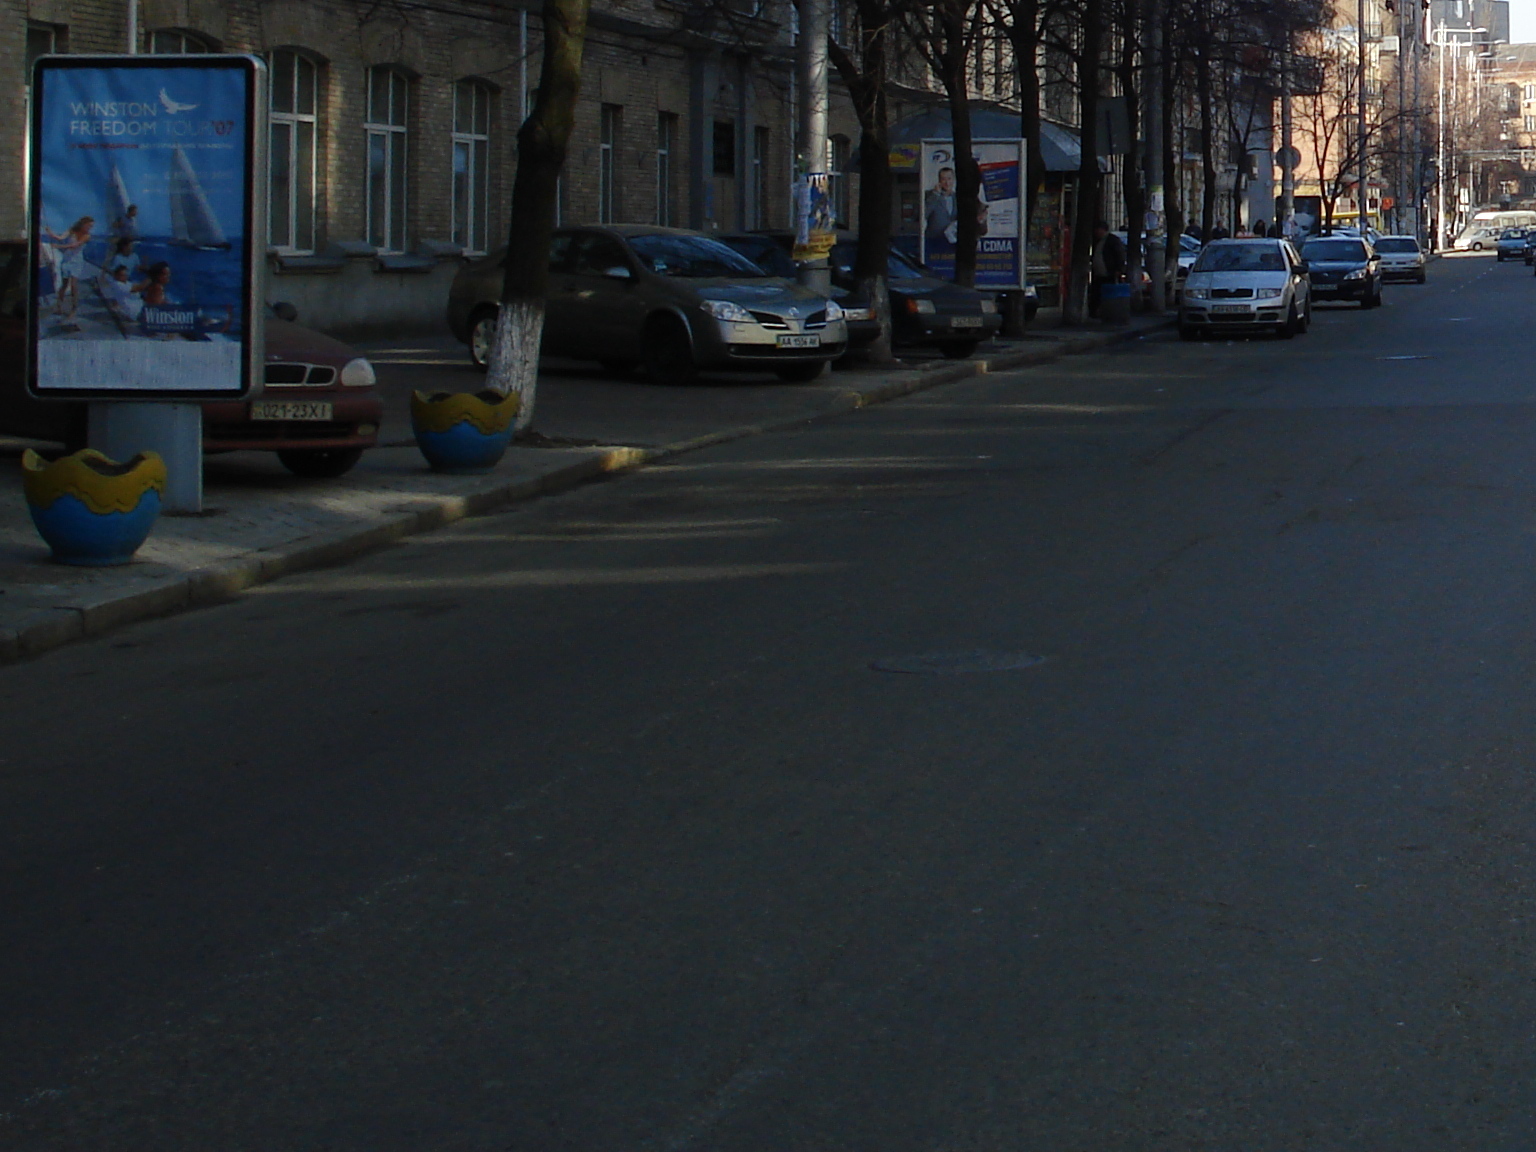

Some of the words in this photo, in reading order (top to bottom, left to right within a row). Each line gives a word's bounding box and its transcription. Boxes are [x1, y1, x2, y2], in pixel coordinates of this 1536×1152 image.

[71, 101, 157, 118] WINSTON
[70, 120, 157, 136] FREEDOM
[983, 239, 1014, 253] CDMA
[144, 307, 195, 325] Winston
